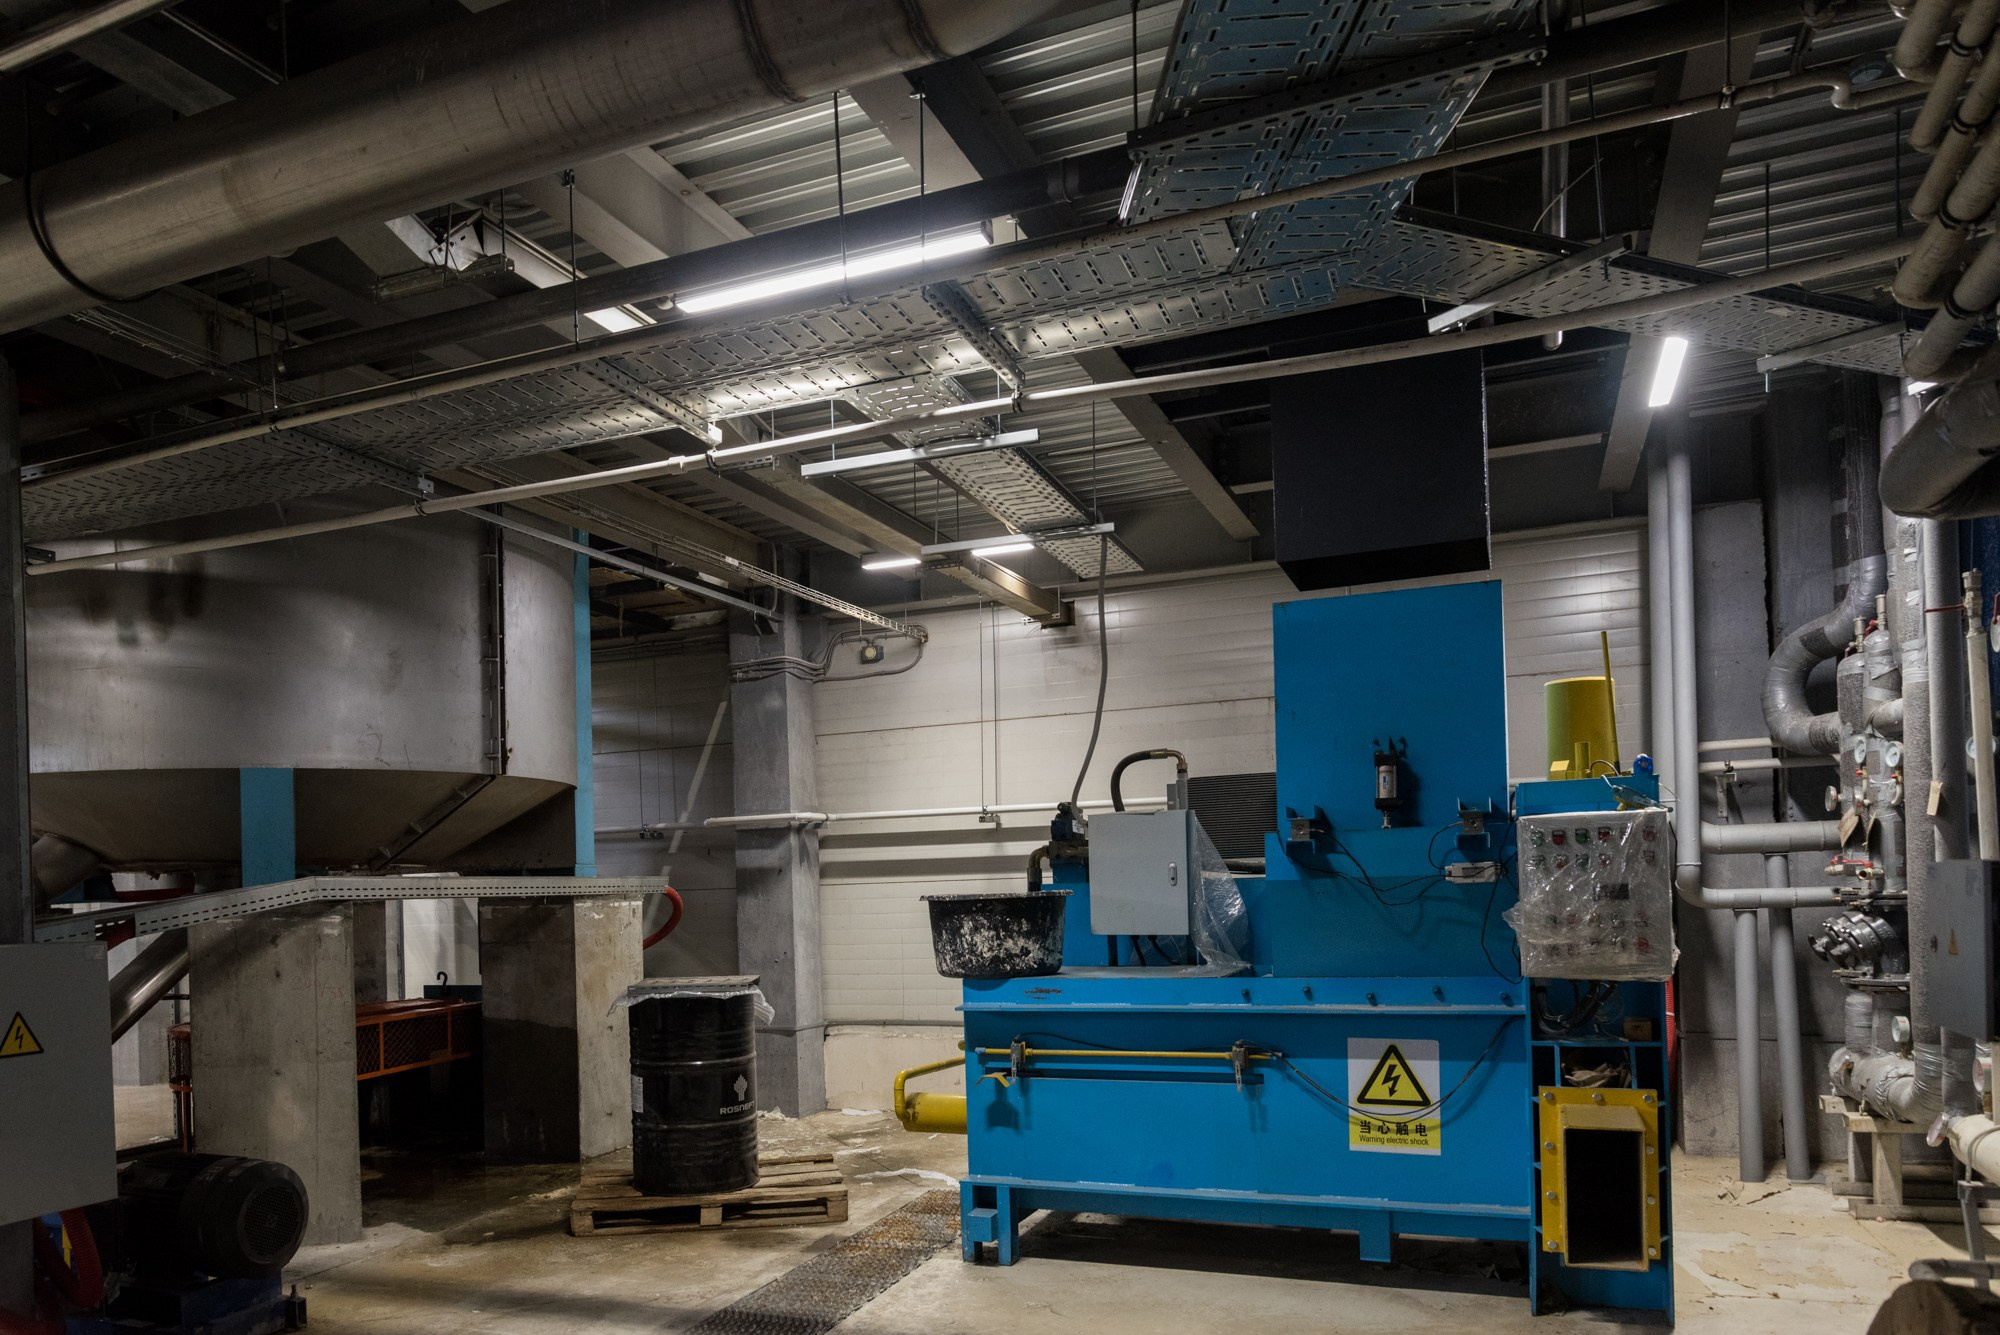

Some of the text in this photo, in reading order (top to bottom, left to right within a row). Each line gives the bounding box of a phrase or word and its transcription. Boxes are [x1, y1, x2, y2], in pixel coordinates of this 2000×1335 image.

[720, 1100, 755, 1115] ROSNEFT
[1360, 1120, 1428, 1137] 当心触电
[1359, 1135, 1429, 1146] Warning electric shock
